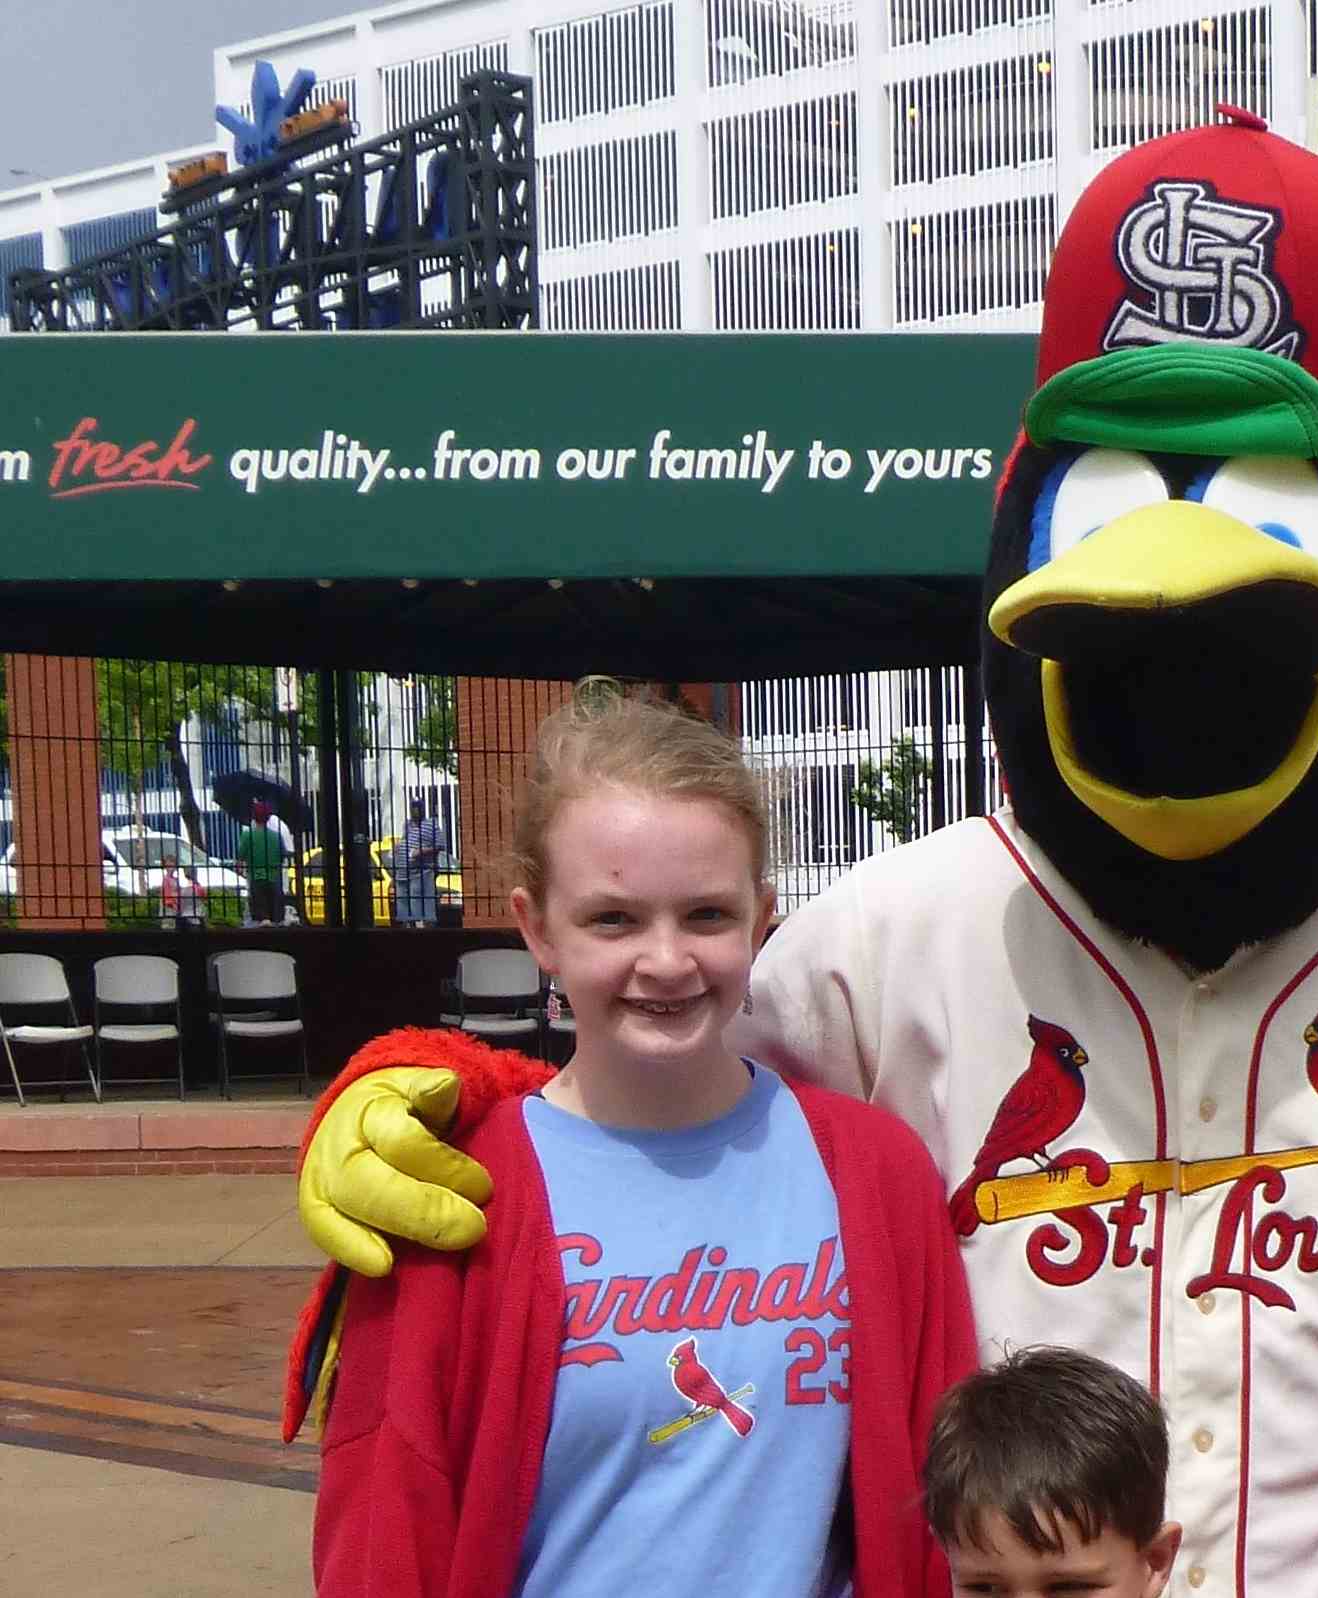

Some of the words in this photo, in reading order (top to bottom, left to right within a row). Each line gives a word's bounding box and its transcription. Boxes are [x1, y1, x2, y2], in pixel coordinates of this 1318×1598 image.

[48, 416, 213, 488] fresh
[556, 448, 637, 480] our
[649, 429, 794, 493] family
[808, 440, 852, 479] to
[863, 448, 992, 493] yours
